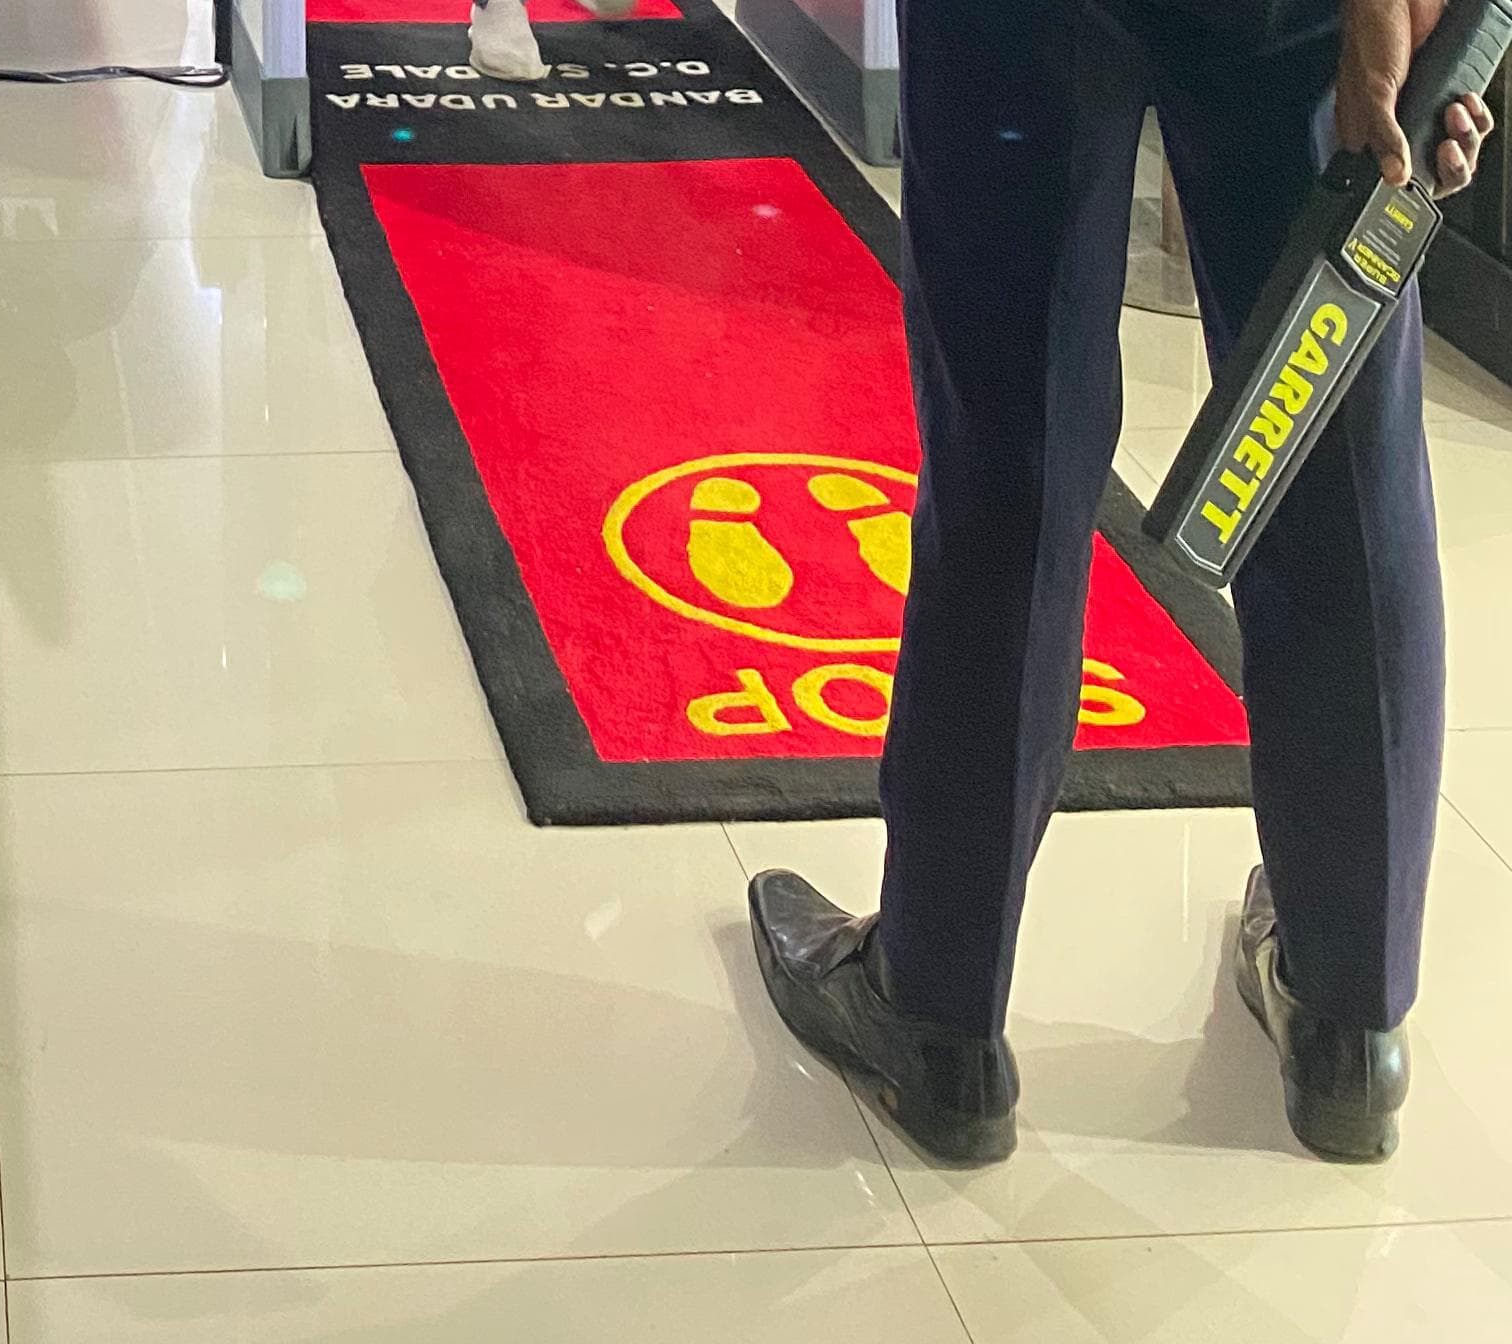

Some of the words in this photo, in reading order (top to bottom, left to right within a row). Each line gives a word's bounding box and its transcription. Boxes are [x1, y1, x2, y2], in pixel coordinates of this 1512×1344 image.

[324, 90, 517, 111] UDARA
[529, 87, 763, 110] BANDAR
[1353, 253, 1388, 285] SUPER
[1200, 302, 1348, 545] GARRETT
[685, 657, 1146, 737] SOP
